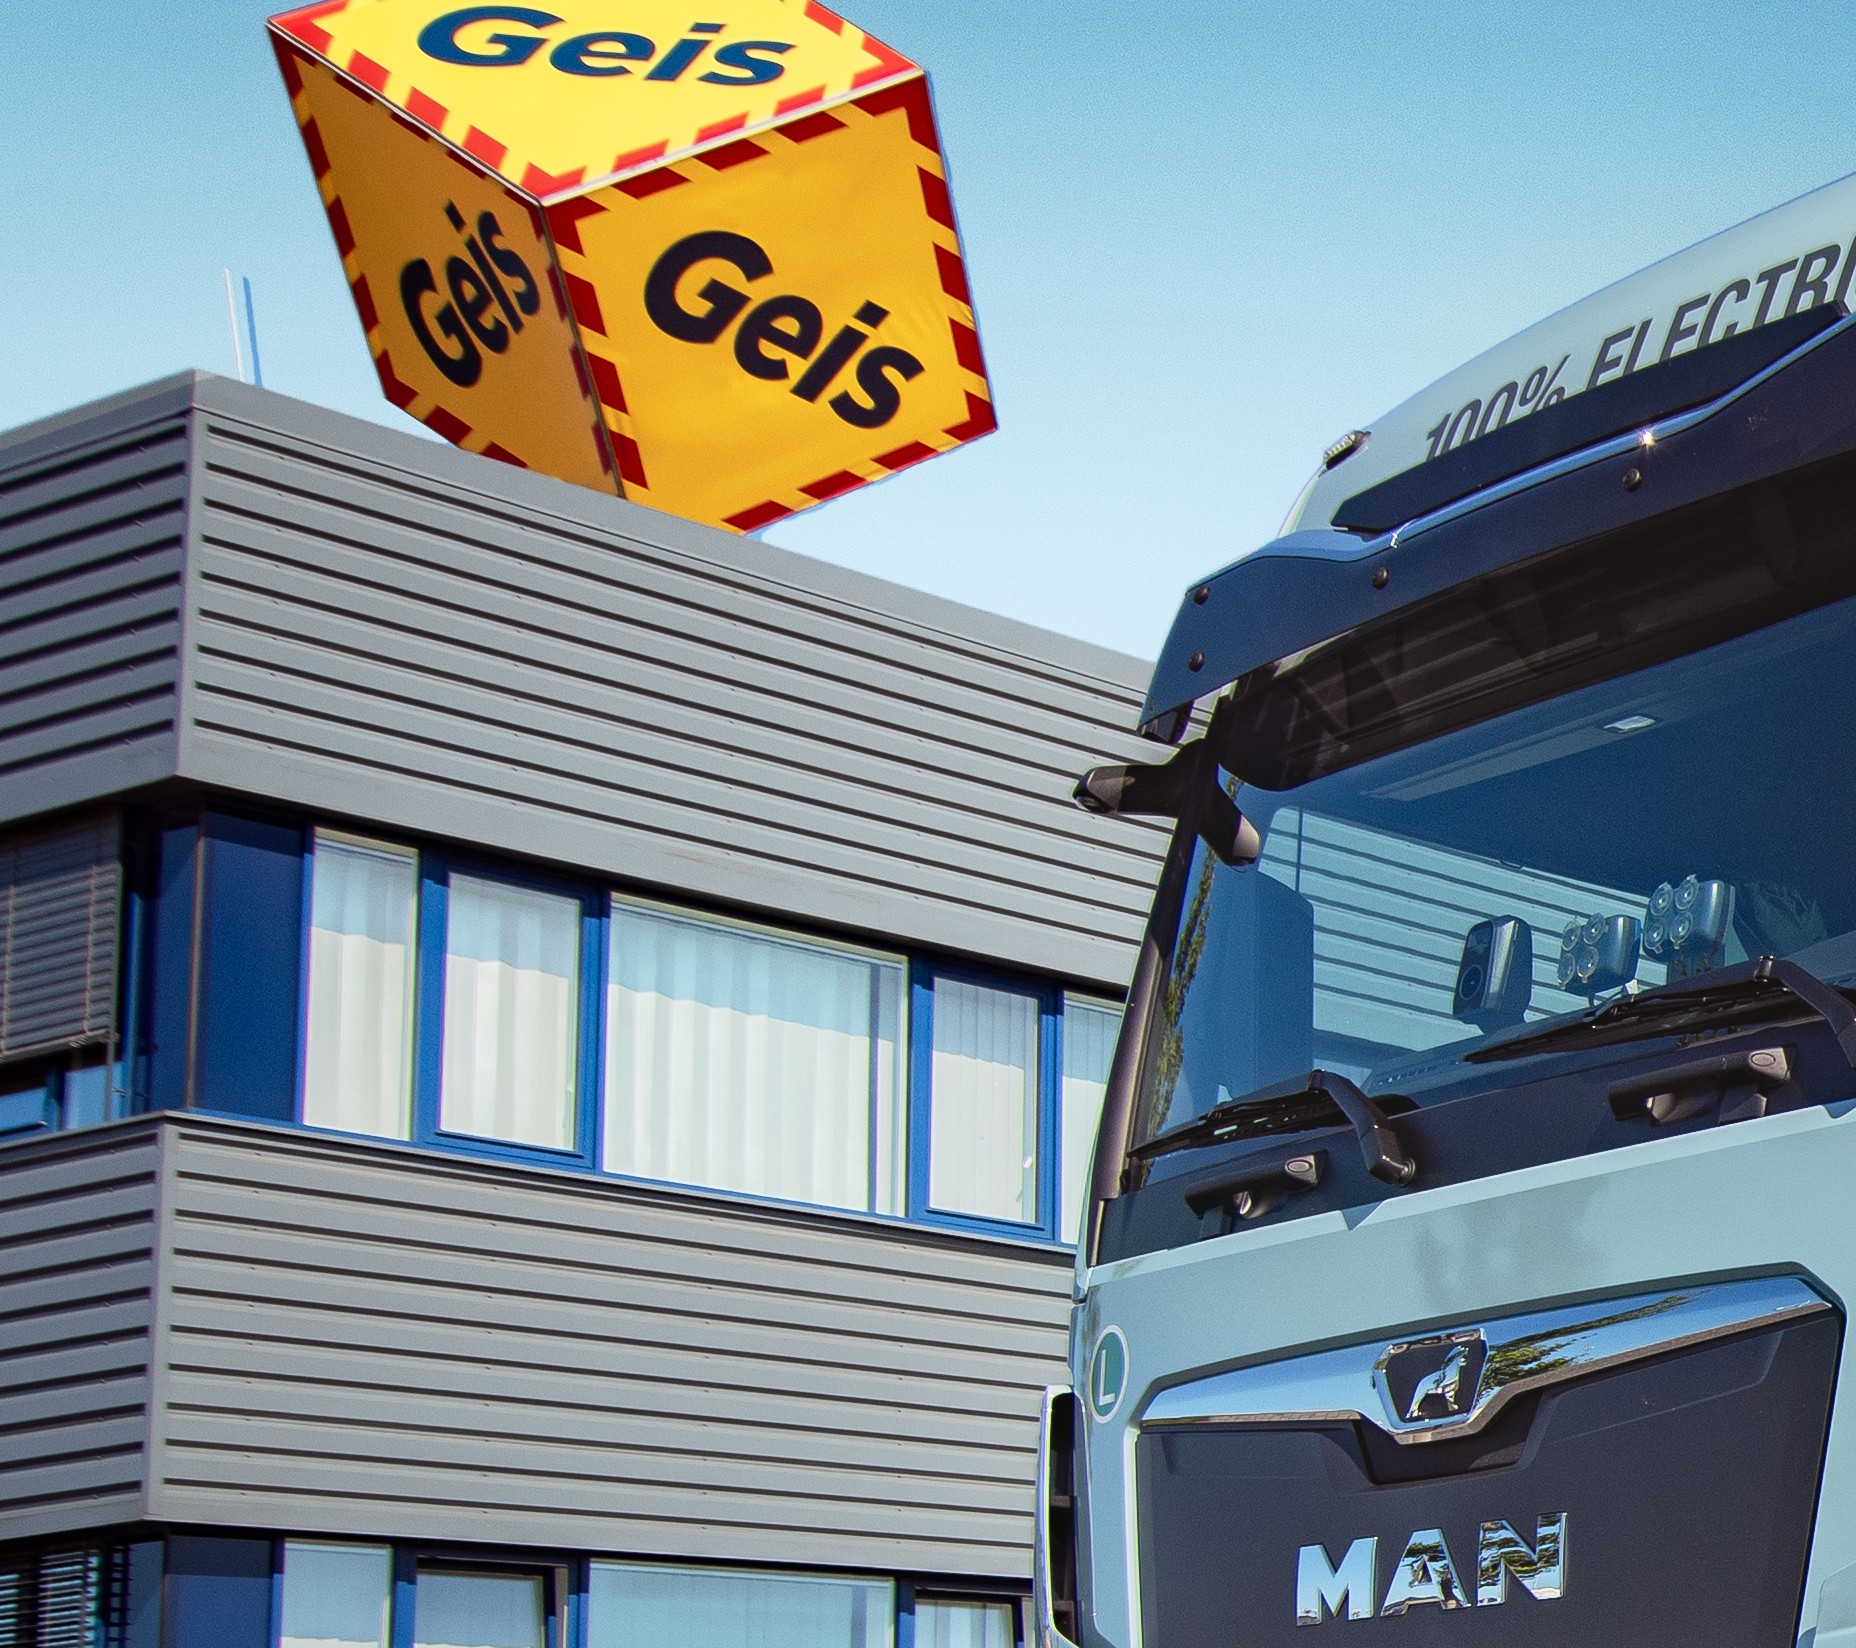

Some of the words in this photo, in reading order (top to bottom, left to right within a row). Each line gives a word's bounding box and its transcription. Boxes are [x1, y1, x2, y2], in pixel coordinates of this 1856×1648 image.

[417, 5, 797, 86] Geis
[400, 201, 541, 388] Geis
[642, 230, 925, 430] Geis
[1098, 1355, 1116, 1406] L
[1295, 1512, 1568, 1626] MAN
